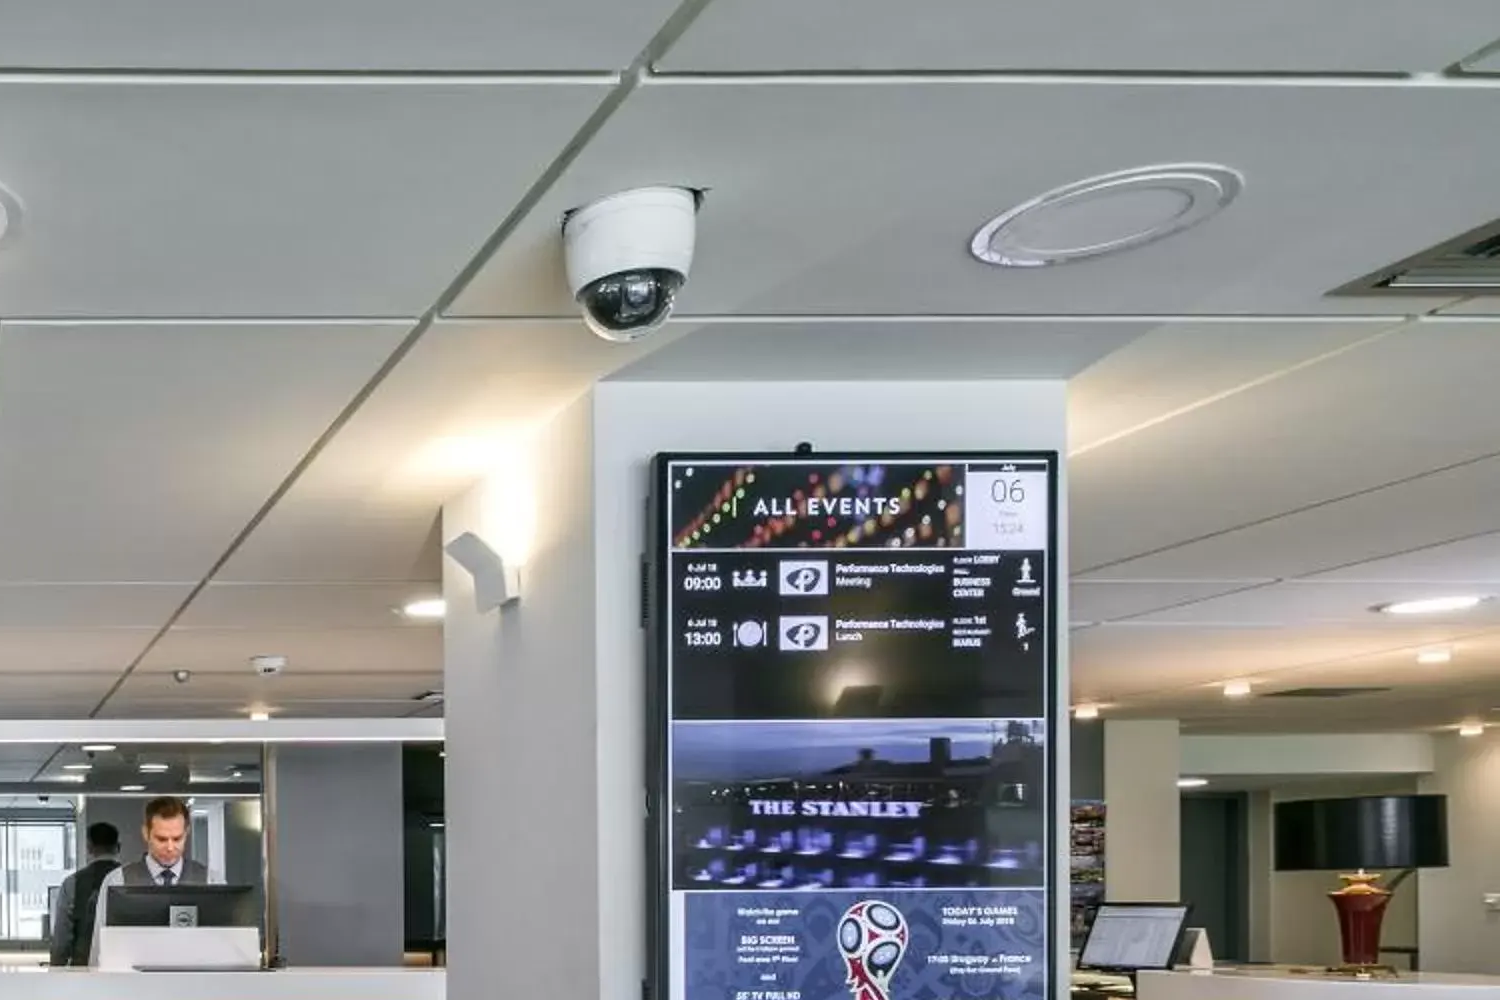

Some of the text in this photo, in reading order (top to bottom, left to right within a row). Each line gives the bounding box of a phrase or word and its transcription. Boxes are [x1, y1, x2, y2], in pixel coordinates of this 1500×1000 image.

[991, 479, 1025, 503] 06
[753, 498, 900, 516] ALL EVENTS
[835, 563, 889, 574] Performance
[890, 563, 945, 575] Technologies
[684, 576, 721, 591] 09:00
[835, 577, 872, 589] Meeting
[835, 619, 889, 629] Performance
[890, 619, 945, 631] Technologies
[683, 631, 721, 646] 13:00
[835, 631, 863, 641] Lunch
[750, 800, 922, 818] THE STANLEY
[741, 935, 759, 945] BIG
